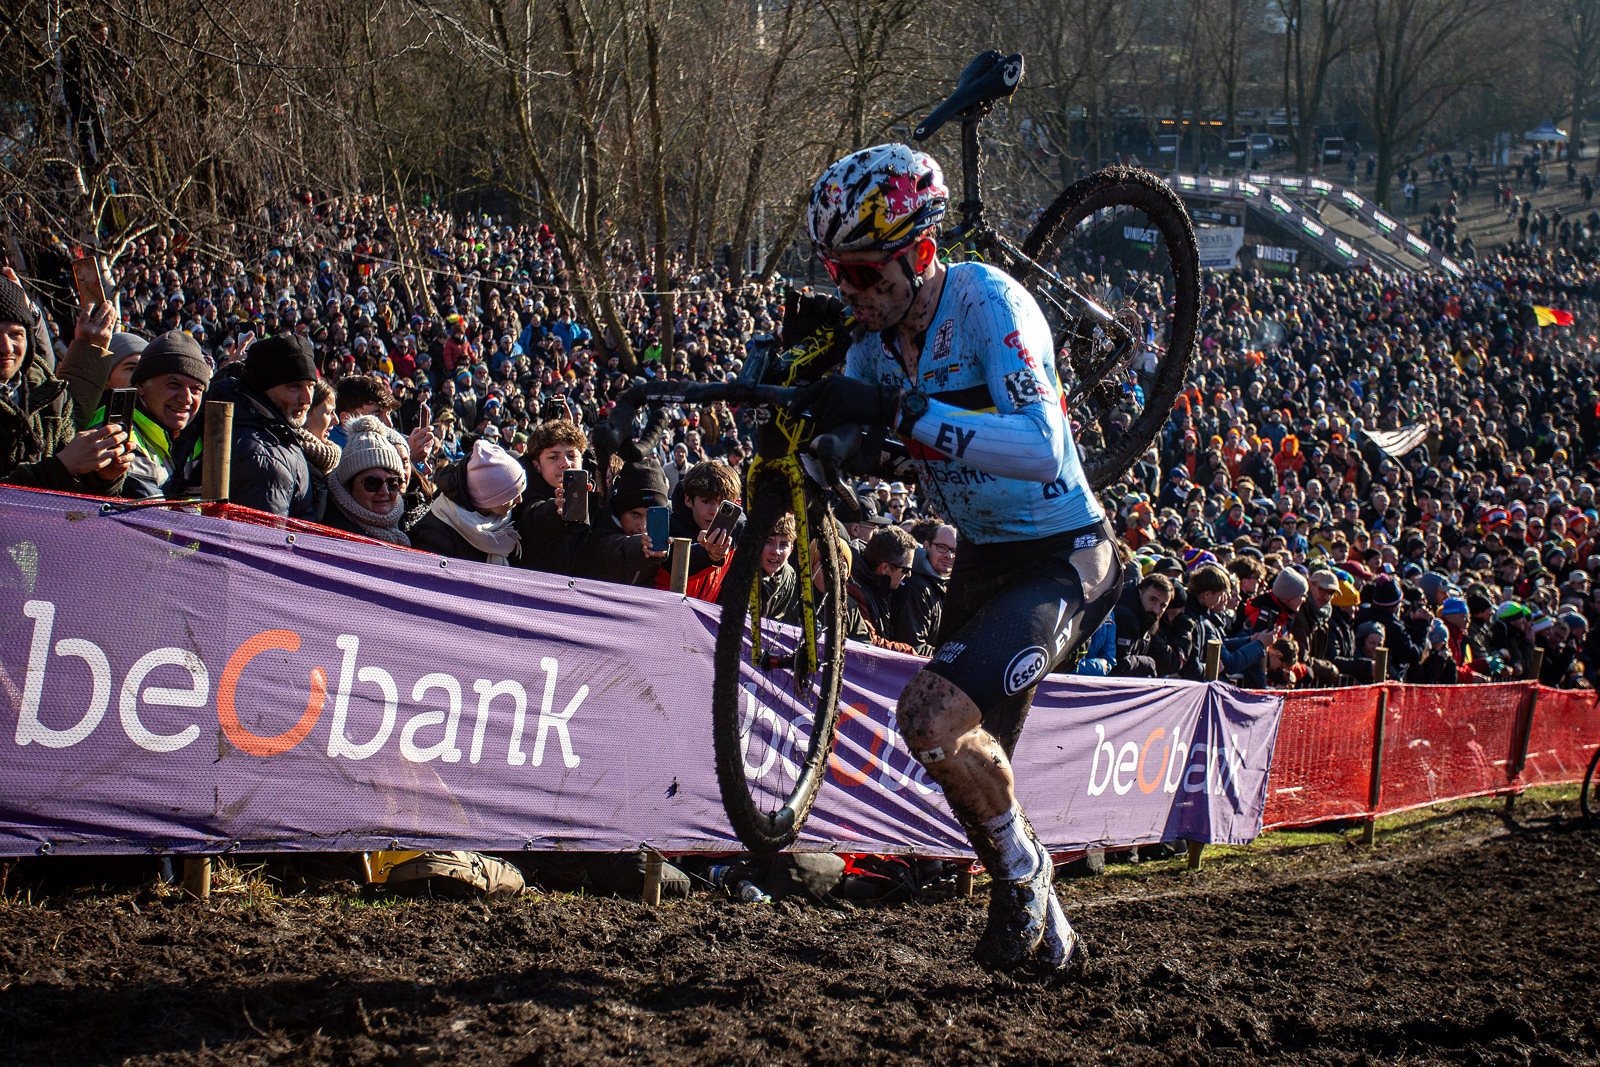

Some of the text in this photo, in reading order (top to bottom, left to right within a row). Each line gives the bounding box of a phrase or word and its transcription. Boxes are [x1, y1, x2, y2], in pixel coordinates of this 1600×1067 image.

[1256, 243, 1299, 265] UNIBET
[934, 423, 976, 458] EY
[1055, 617, 1073, 656] EY
